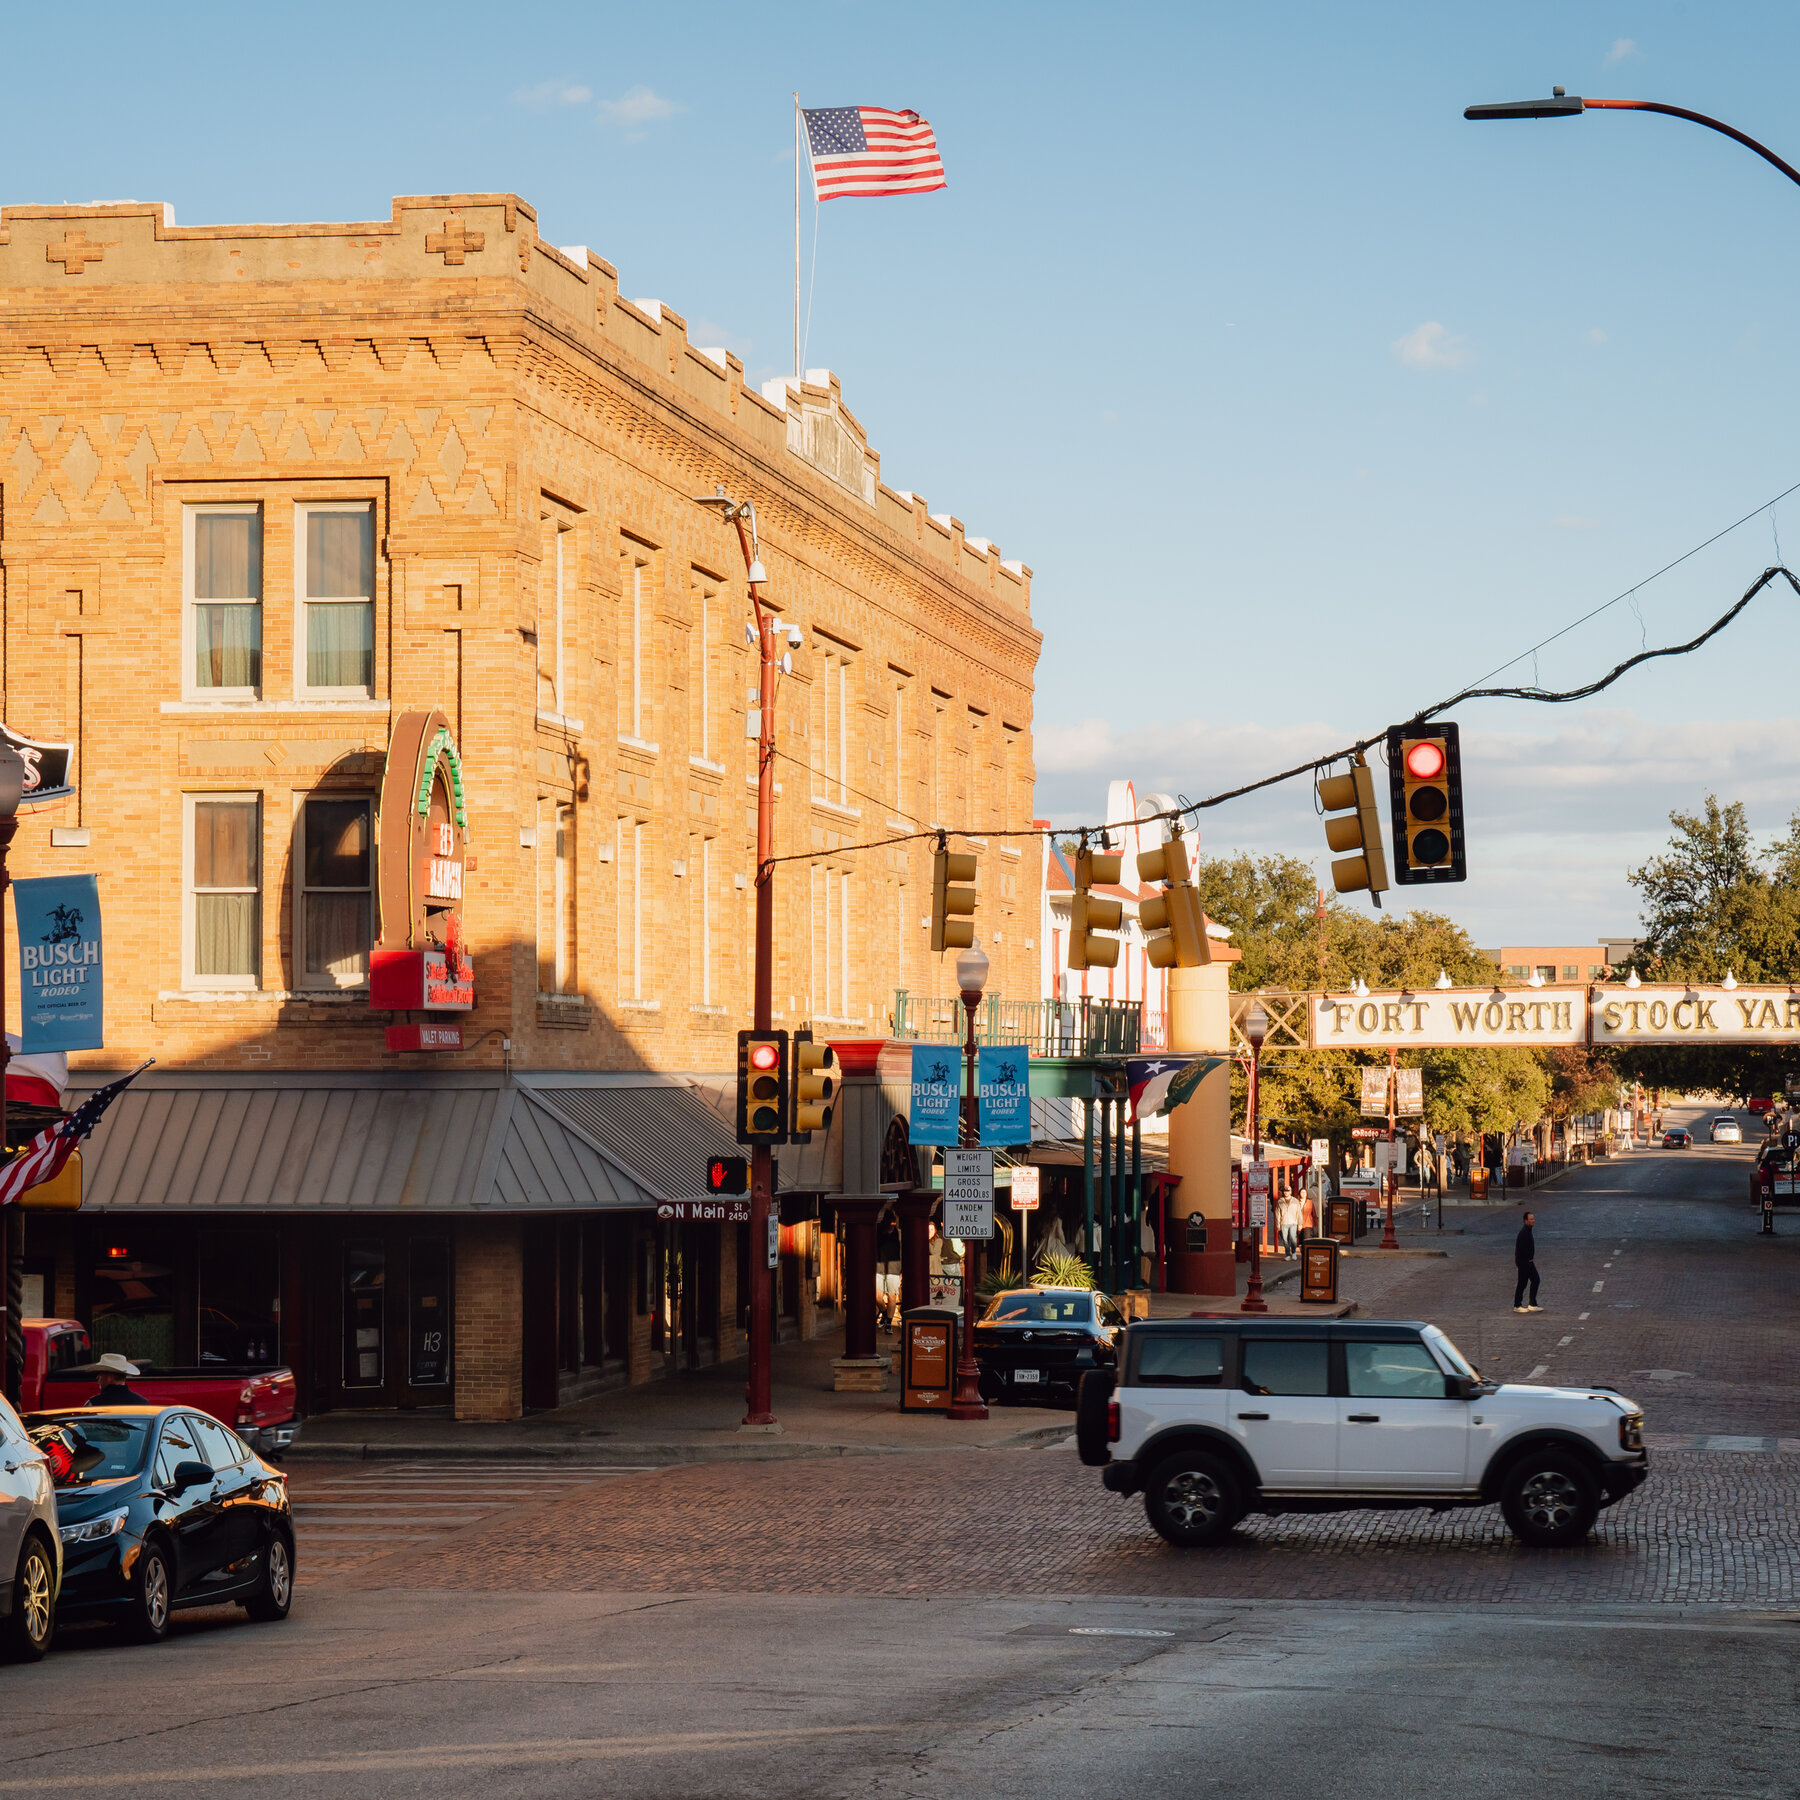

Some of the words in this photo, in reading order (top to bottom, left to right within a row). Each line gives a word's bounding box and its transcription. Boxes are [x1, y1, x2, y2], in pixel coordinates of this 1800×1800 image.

[23, 941, 100, 970] BUSCH
[32, 967, 88, 987] LIGHT
[40, 986, 80, 997] RODEO
[1331, 1001, 1430, 1035] FORT
[1450, 1001, 1572, 1035] WORTH
[1602, 1000, 1719, 1034] STOCK
[1734, 998, 1800, 1032] YAR
[421, 1030, 437, 1044] VALET
[438, 1031, 460, 1044] PARKING
[912, 1083, 958, 1098] BUSCH
[980, 1083, 1026, 1098] BUSCH
[916, 1098, 950, 1108] LIGHT
[985, 1098, 1020, 1108] LIGHT
[1360, 1129, 1379, 1137] Rodeo
[956, 1153, 982, 1161] WEIGHT
[957, 1165, 981, 1173] LIMITS
[675, 1203, 685, 1219] N
[692, 1203, 725, 1219] Main
[734, 1202, 743, 1211] St
[728, 1212, 748, 1221] 2450
[423, 1332, 441, 1352] H3
